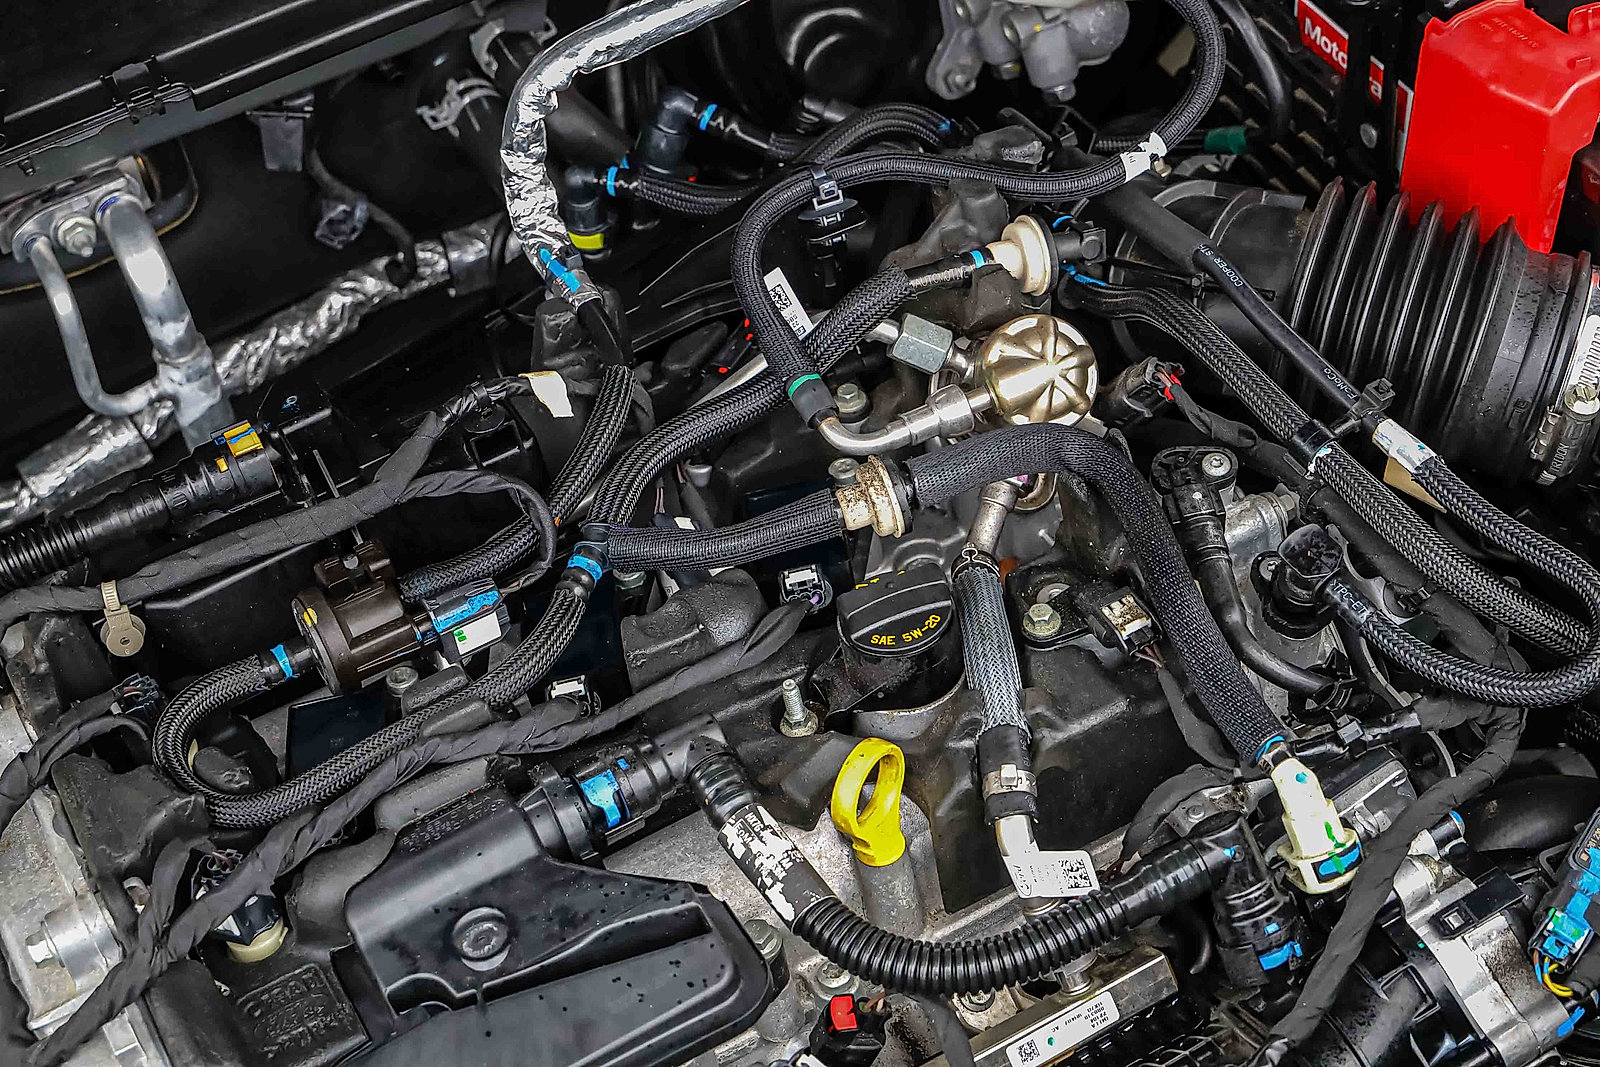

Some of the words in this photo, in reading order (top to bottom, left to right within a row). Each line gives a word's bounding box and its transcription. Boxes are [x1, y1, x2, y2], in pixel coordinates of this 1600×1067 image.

[1213, 257, 1243, 287] COOPER
[870, 634, 896, 646] SAE
[901, 614, 941, 642] 5W-20
